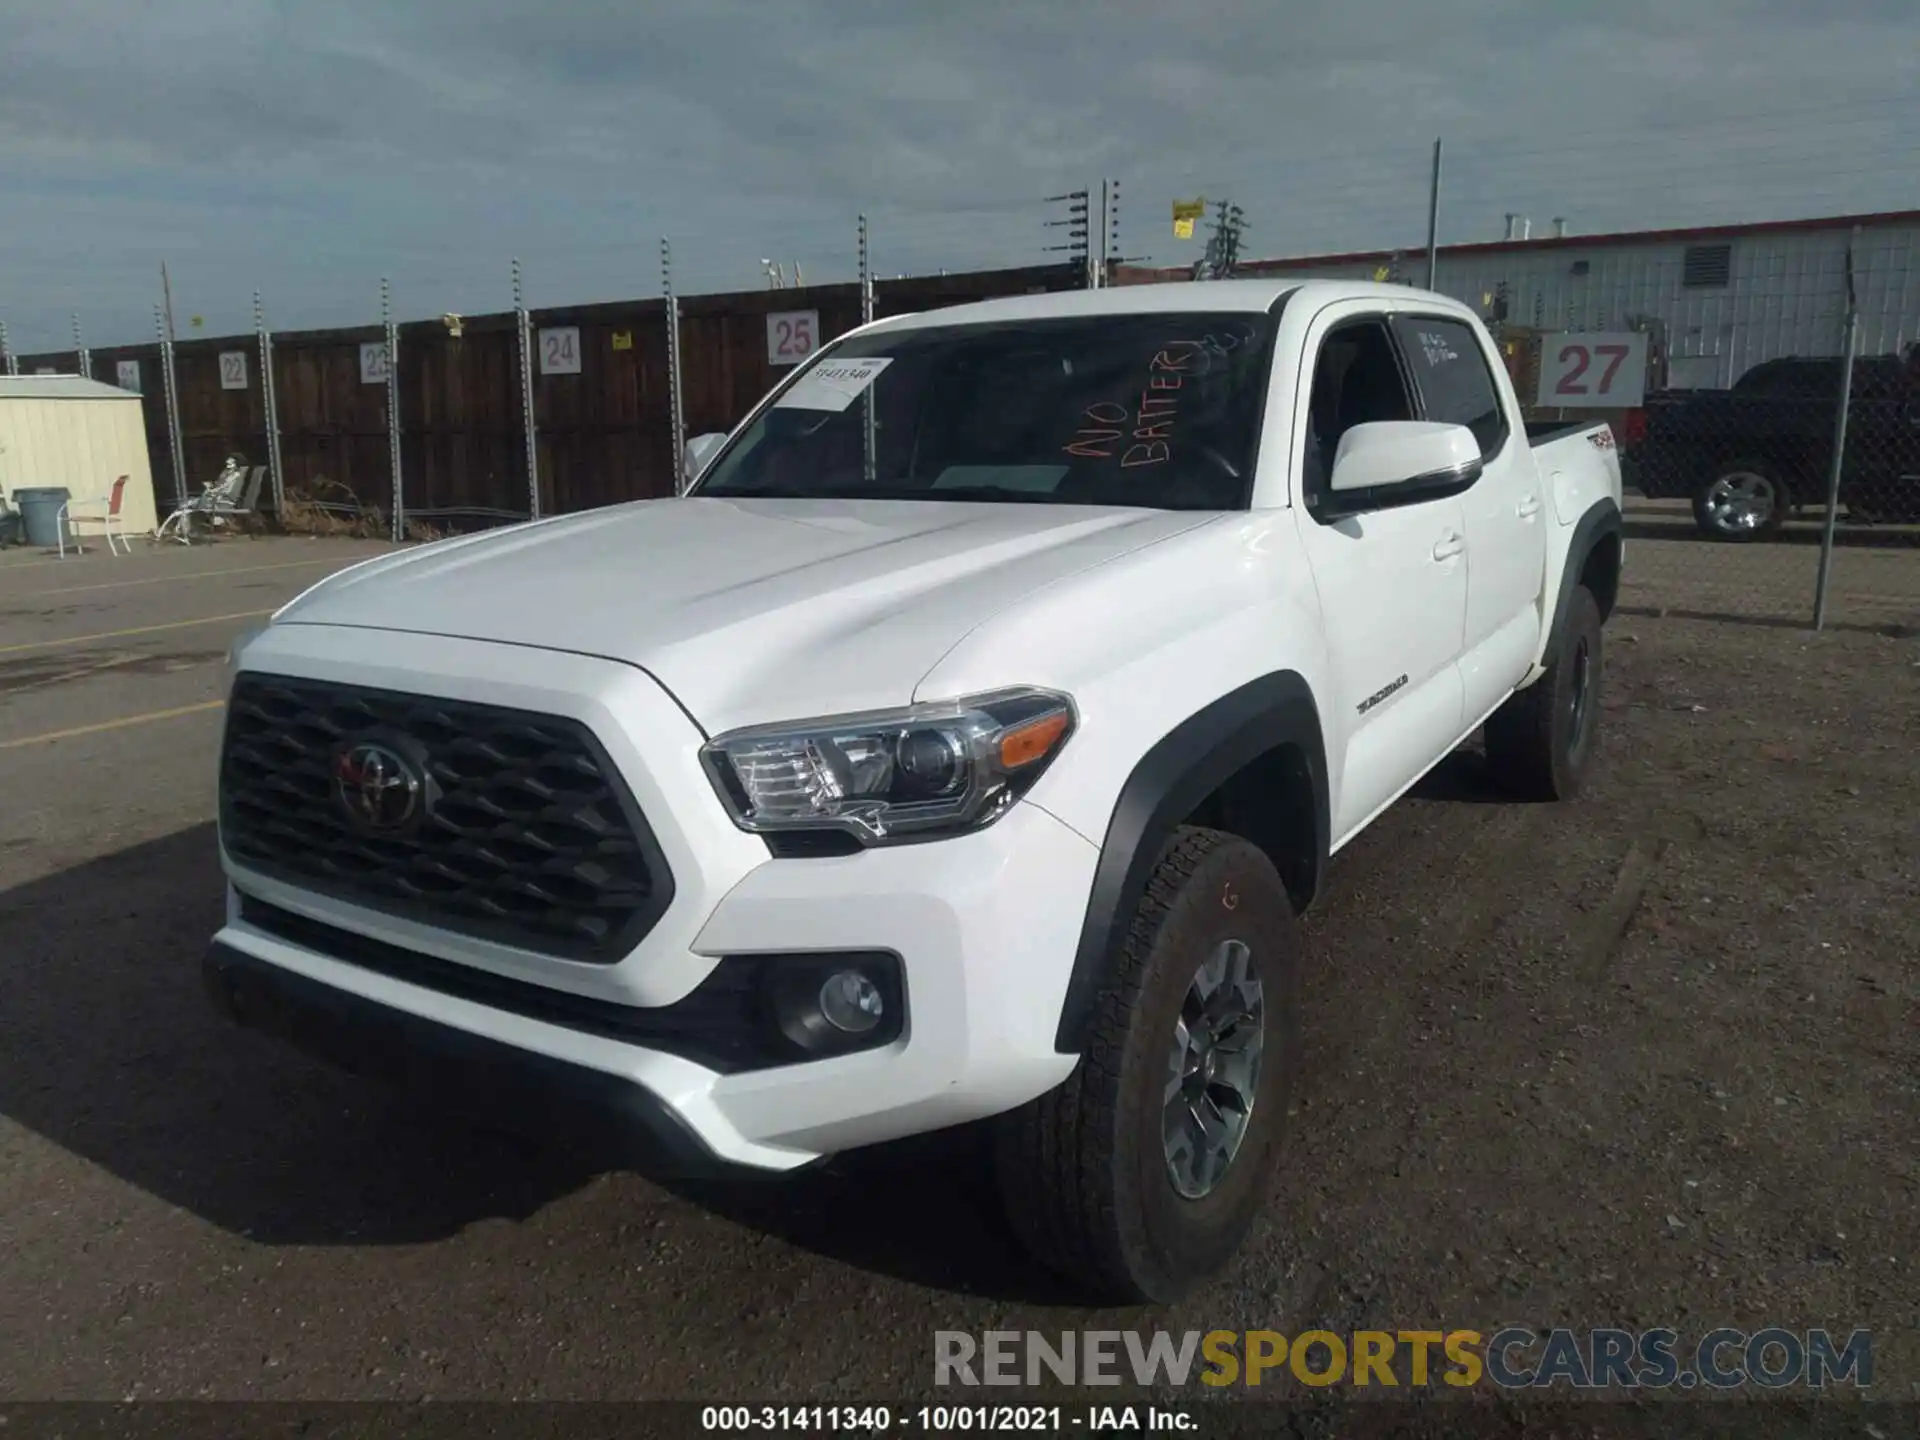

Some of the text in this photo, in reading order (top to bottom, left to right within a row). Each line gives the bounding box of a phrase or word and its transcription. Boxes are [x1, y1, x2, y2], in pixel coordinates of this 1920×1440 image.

[546, 335, 575, 367] 24
[776, 319, 811, 355] 25
[223, 356, 244, 382] 22
[1555, 345, 1630, 395] 27
[1062, 401, 1128, 457] NO
